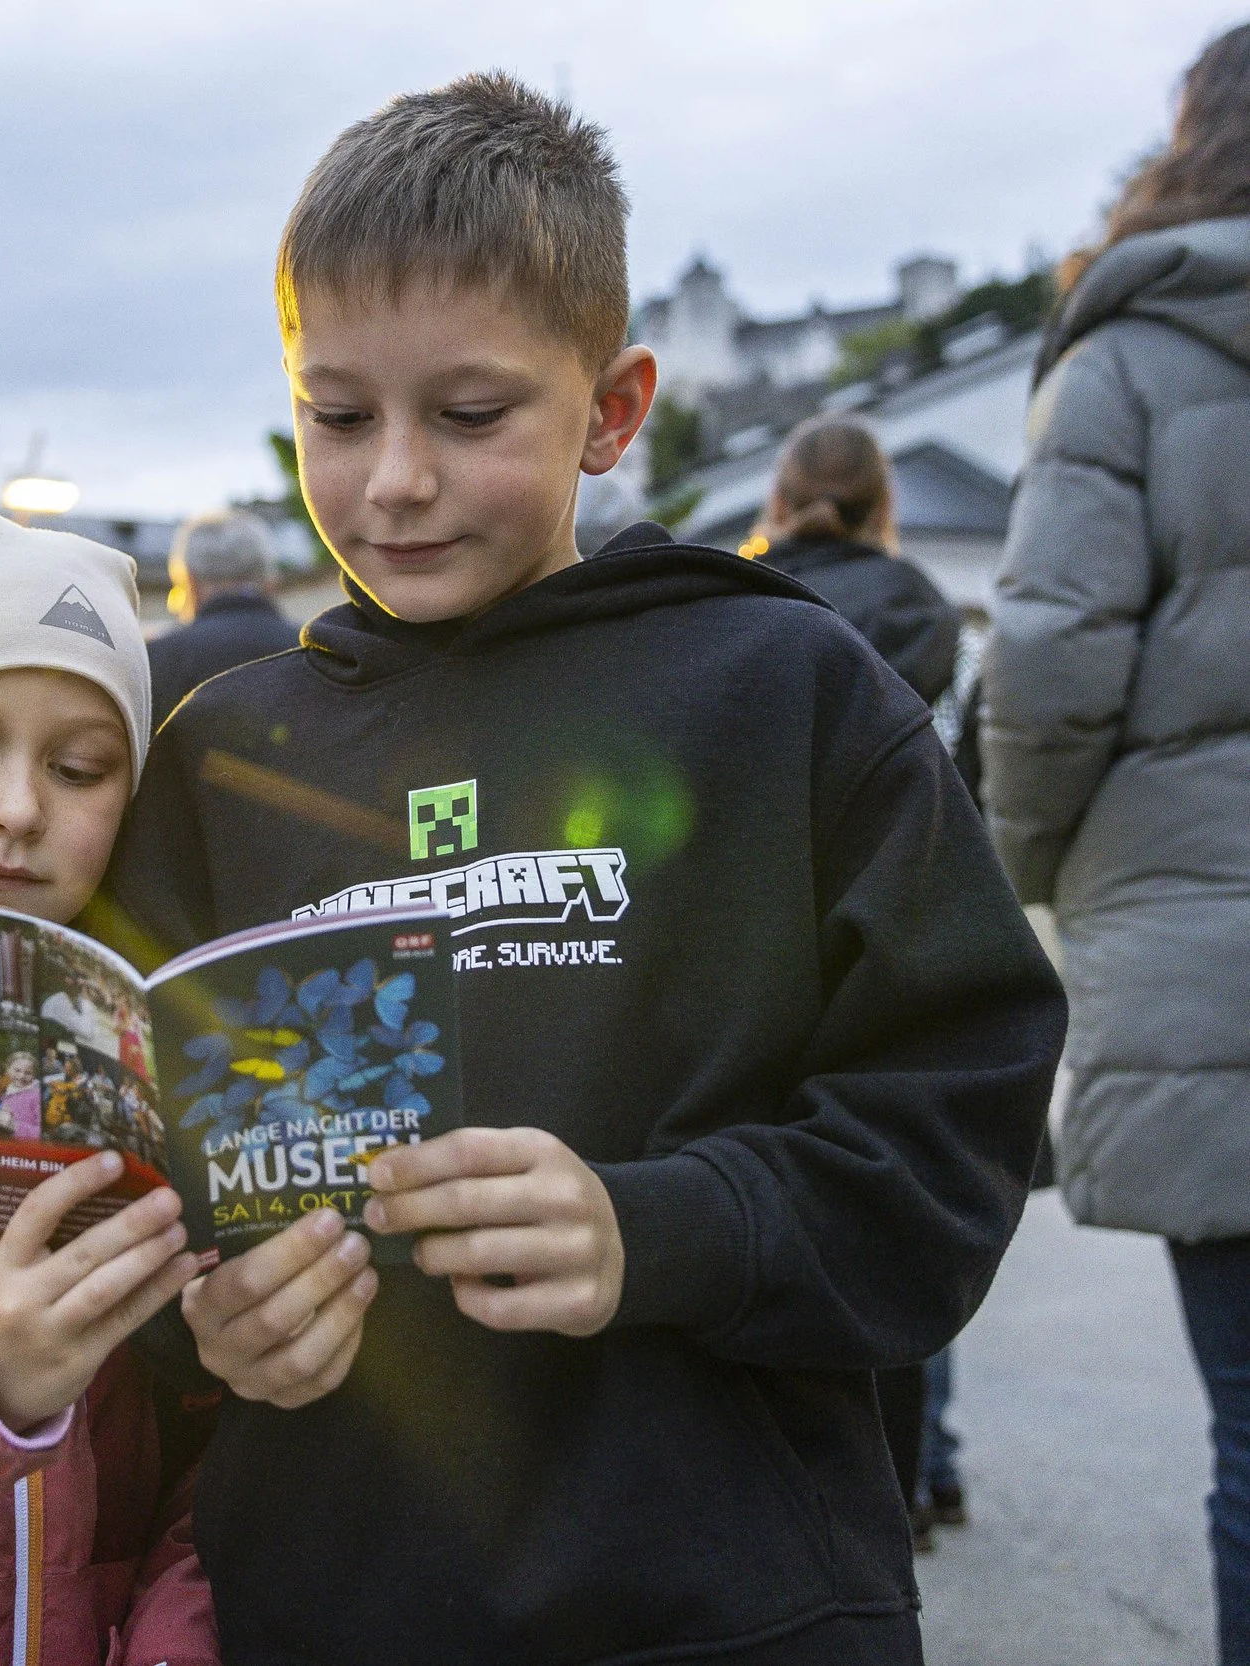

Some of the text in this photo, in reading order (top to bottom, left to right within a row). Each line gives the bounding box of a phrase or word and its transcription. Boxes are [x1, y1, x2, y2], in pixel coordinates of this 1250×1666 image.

[453, 945, 493, 972] RE.
[498, 940, 623, 967] SURVIVE.
[204, 1108, 420, 1158] LANGE NACHT DER
[39, 1159, 66, 1174] BIN
[207, 1133, 422, 1204] MUSEE
[213, 1202, 250, 1226] SA
[268, 1196, 293, 1216] 4.
